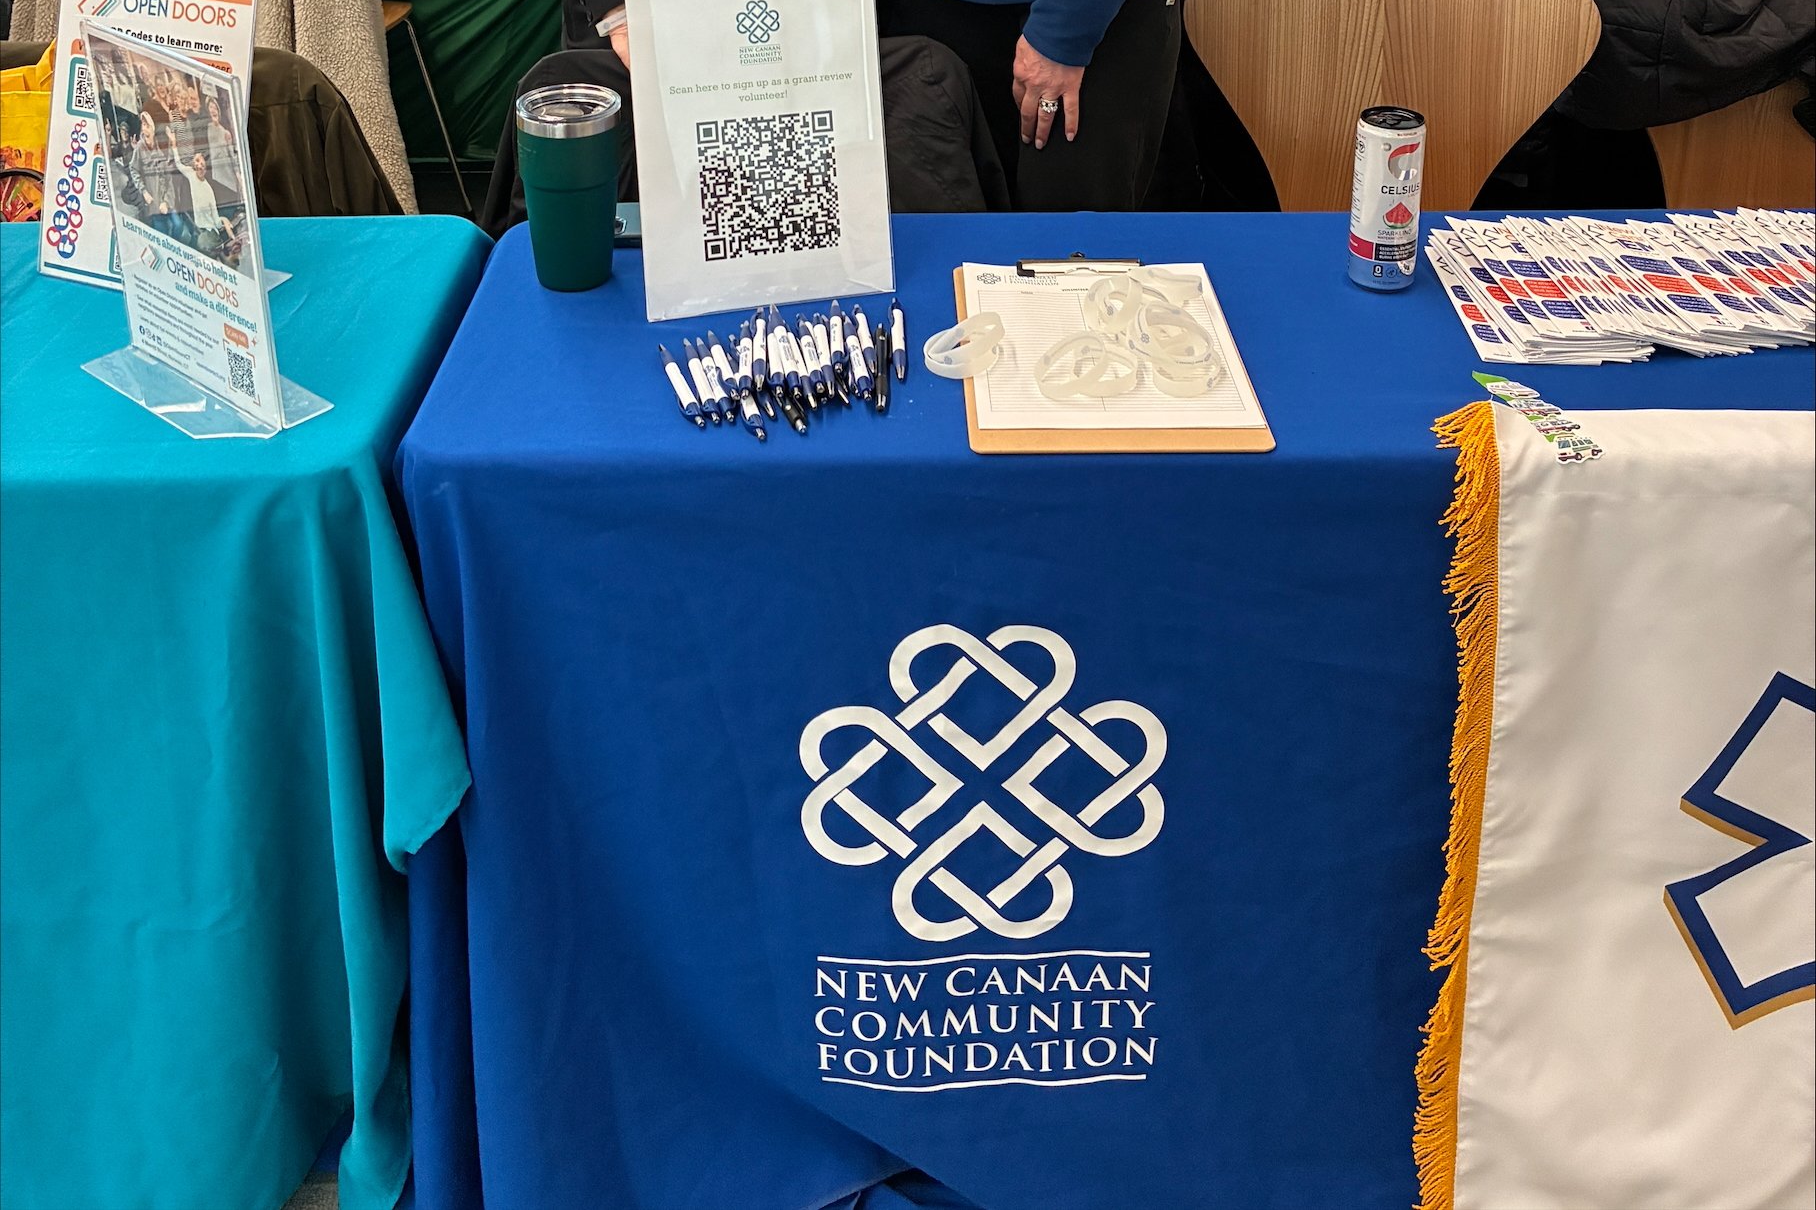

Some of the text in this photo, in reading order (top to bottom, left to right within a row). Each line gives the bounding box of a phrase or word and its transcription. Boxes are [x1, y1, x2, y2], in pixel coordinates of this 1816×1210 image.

[172, 0, 237, 28] DOORS
[155, 34, 165, 44] to
[167, 36, 192, 48] learn
[194, 42, 223, 53] more:
[740, 56, 783, 64] FOUNDATION
[669, 86, 693, 95] Scan
[696, 84, 719, 93] here
[733, 80, 754, 91] sign
[756, 80, 768, 89] up
[792, 74, 818, 87] grant
[820, 72, 853, 82] review
[738, 90, 789, 102] volunteer!
[1381, 182, 1420, 195] CELSIUS
[122, 217, 142, 236] Learn
[143, 231, 162, 247] more
[162, 238, 183, 257] about
[204, 260, 211, 272] to
[212, 262, 228, 280] help
[228, 275, 238, 286] at
[166, 257, 196, 286] OPEN
[197, 272, 239, 308] DOORS
[175, 282, 189, 295] and
[188, 289, 209, 307] make
[209, 301, 215, 309] a
[215, 302, 258, 334] difference!
[814, 962, 1152, 1003] NEW CANAAN
[814, 1000, 1156, 1041] COMMUNITY
[816, 1037, 1159, 1080] FOUNDATION
